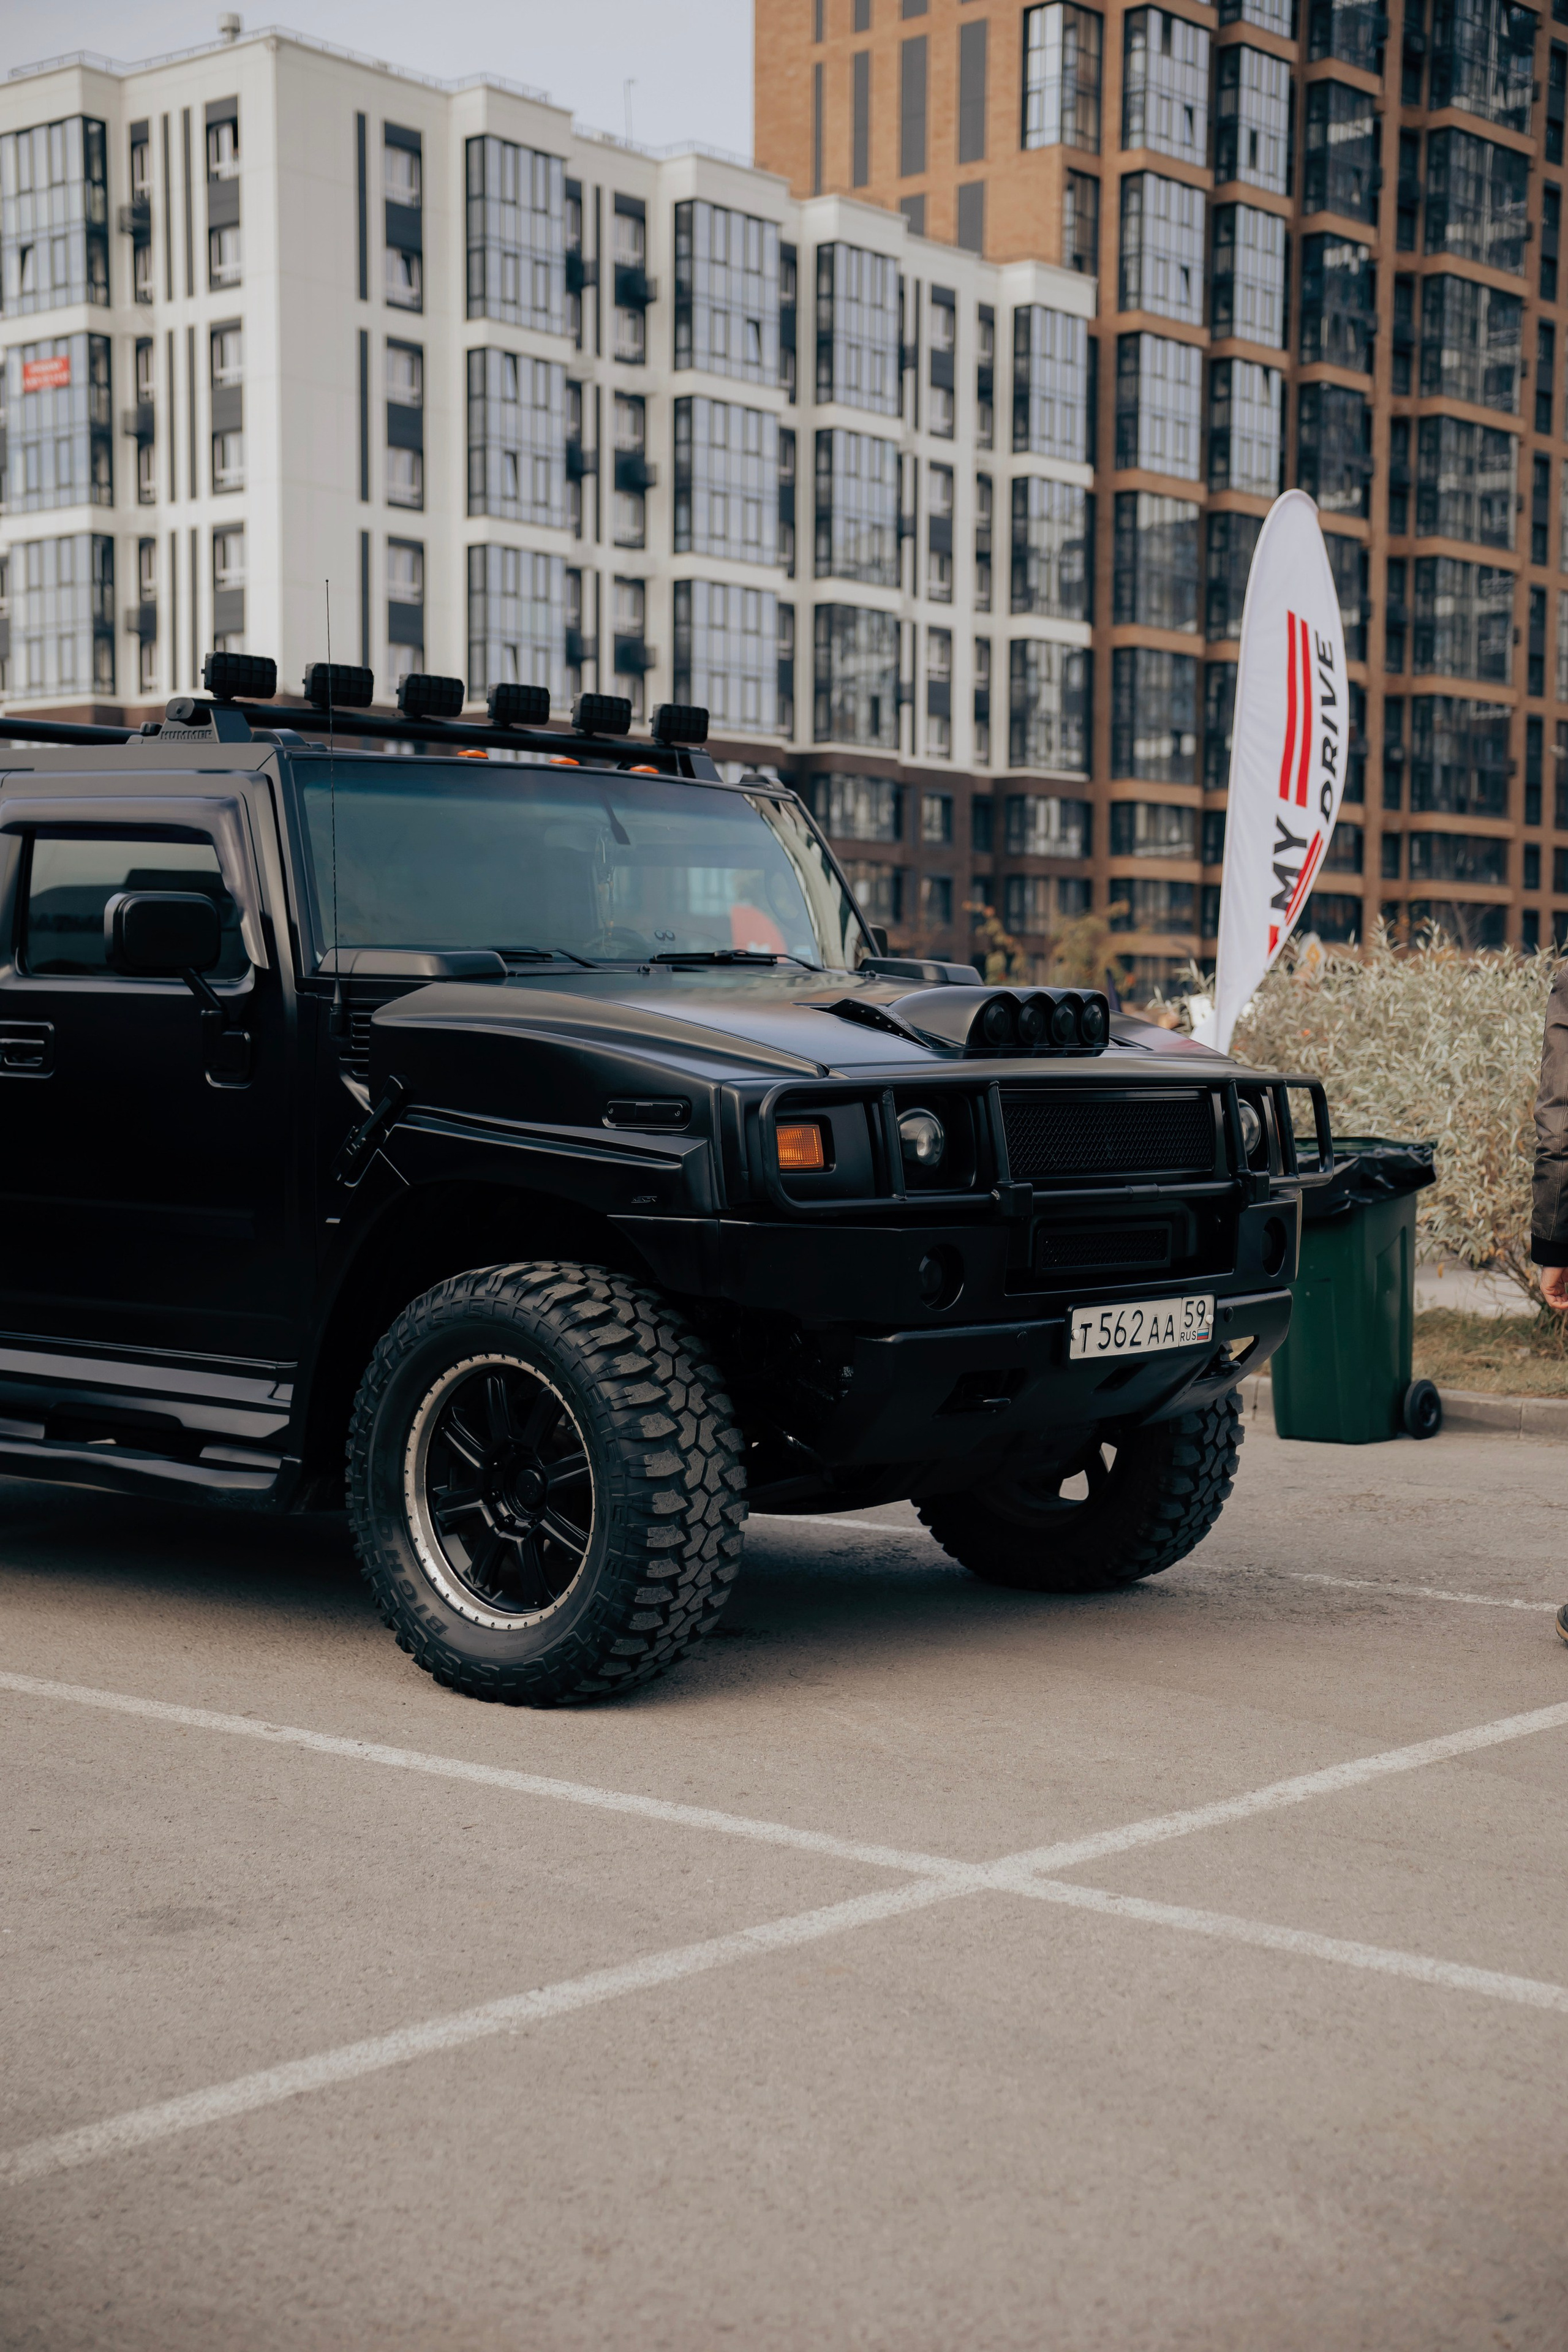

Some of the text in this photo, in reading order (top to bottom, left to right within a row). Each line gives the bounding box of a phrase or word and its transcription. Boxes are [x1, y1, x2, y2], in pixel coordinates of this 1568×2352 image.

[160, 729, 213, 741] HUMMER
[1315, 629, 1339, 824] DRIVE
[1270, 814, 1308, 911] MY
[1183, 1299, 1207, 1329] 59
[1180, 1329, 1197, 1343] RUS
